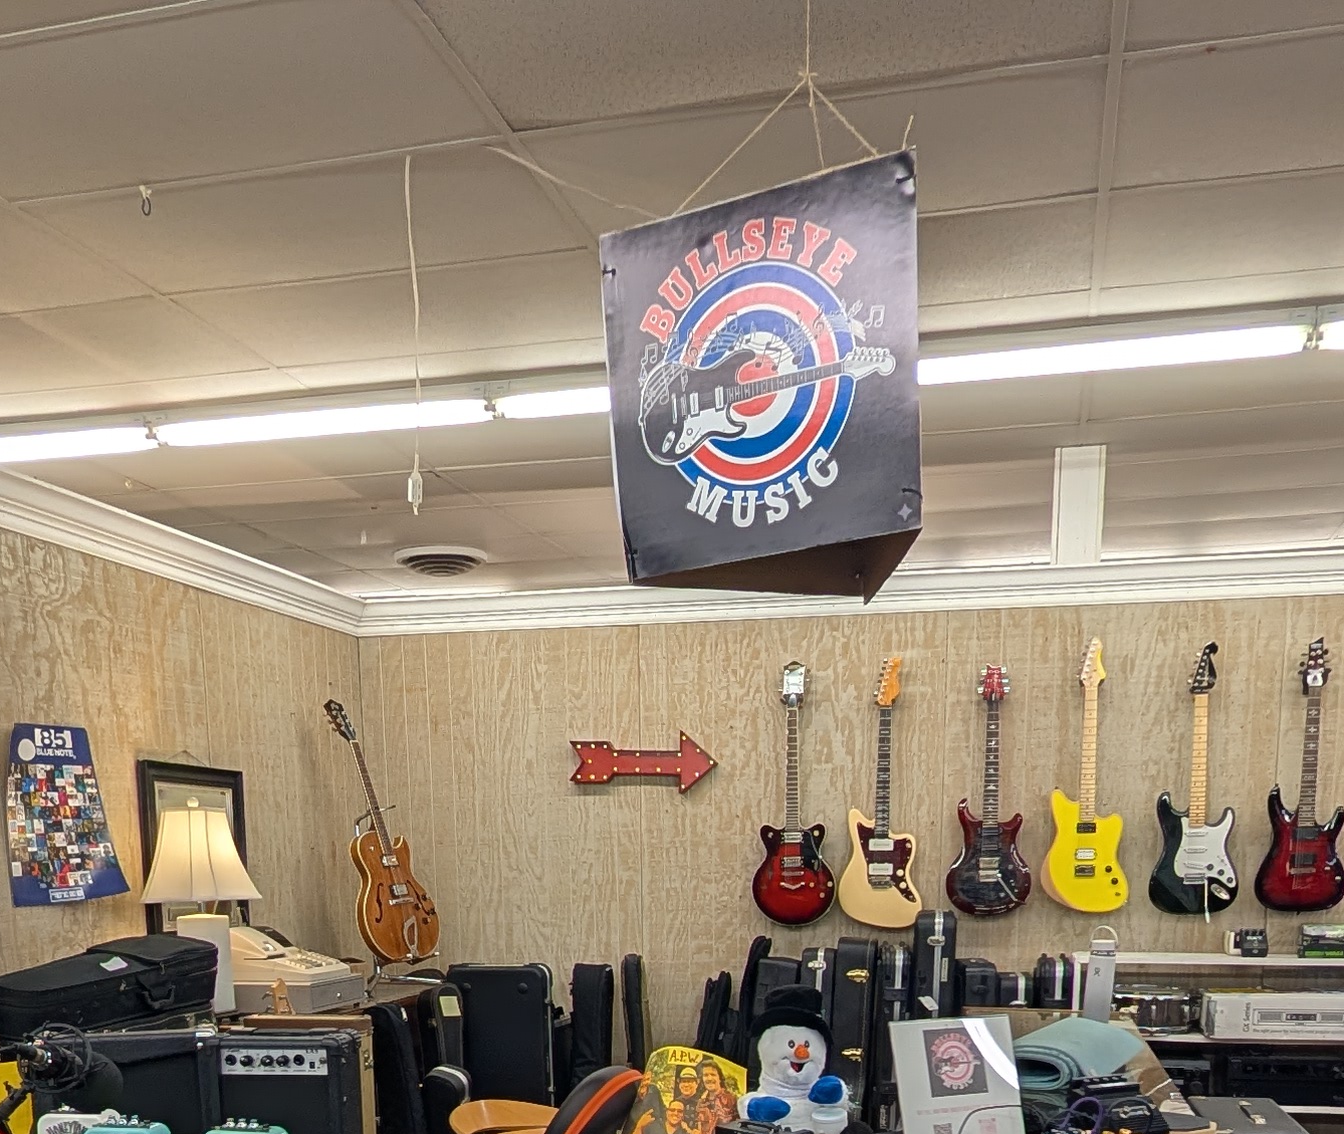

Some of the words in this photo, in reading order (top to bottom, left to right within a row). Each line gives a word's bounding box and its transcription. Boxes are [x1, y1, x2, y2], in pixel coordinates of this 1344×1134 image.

[640, 217, 858, 342] BULLSEYE
[685, 447, 839, 528] MUSIC
[34, 728, 73, 748] 85
[35, 747, 55, 757] BLUE
[55, 748, 74, 758] NOTE
[942, 1079, 974, 1090] MUSIC
